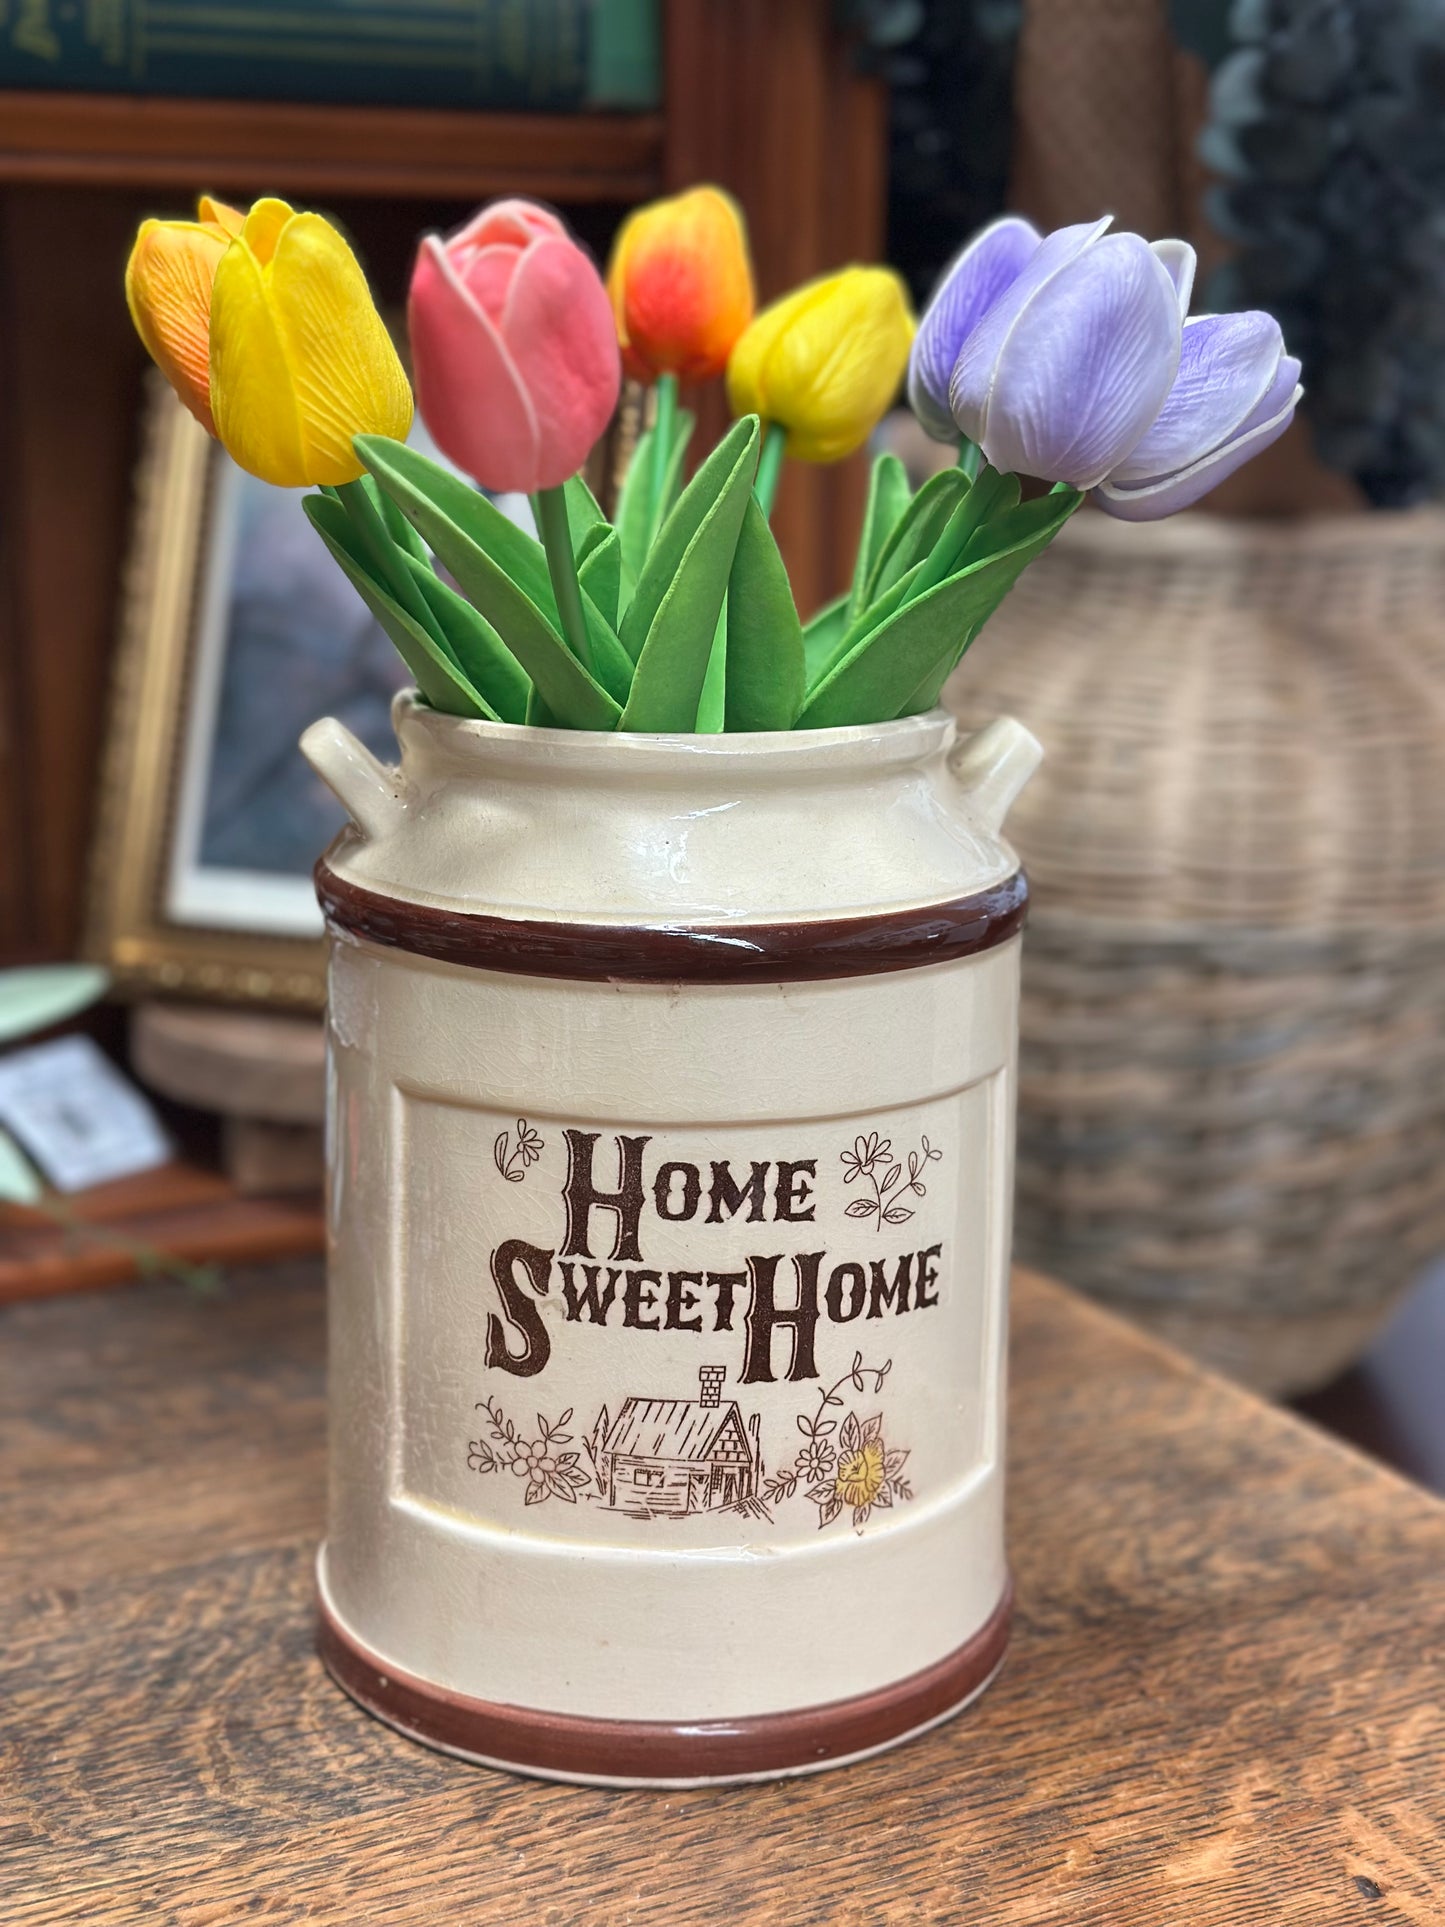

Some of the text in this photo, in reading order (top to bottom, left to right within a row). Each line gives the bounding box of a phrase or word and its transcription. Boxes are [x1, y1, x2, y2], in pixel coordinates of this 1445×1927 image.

[561, 1129, 818, 1261] HOME
[485, 1239, 943, 1384] SWEET HOME
